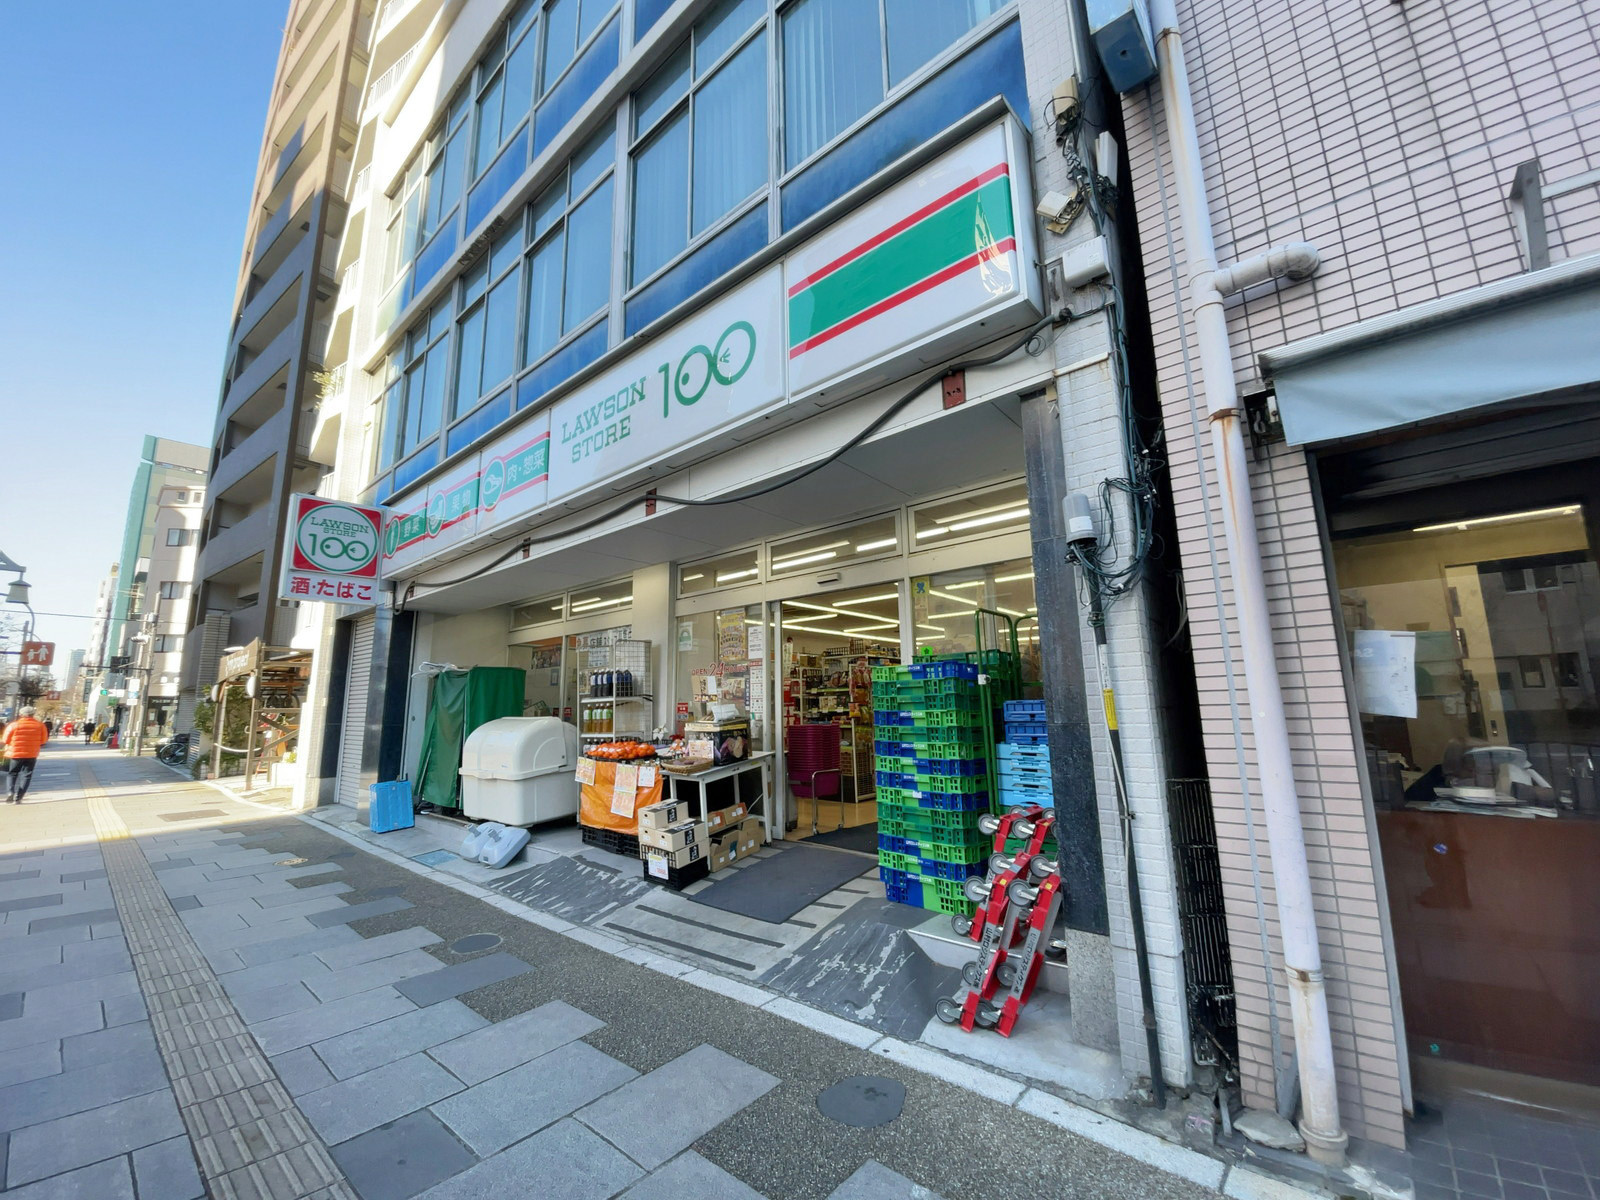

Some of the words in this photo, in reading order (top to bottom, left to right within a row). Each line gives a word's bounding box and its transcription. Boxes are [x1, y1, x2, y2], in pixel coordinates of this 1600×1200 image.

[658, 320, 757, 418] 100
[561, 376, 646, 444] LAWSON
[572, 415, 631, 463] STORE
[506, 448, 545, 484] 肉・惣菜
[452, 489, 471, 512] 果物
[311, 517, 369, 534] LAWSON
[323, 527, 357, 538] STORE
[403, 517, 420, 538] 野菜
[309, 533, 369, 562] 100
[290, 576, 372, 601] 酒・たばこ
[691, 668, 708, 676] OPEN
[710, 662, 724, 678] 24
